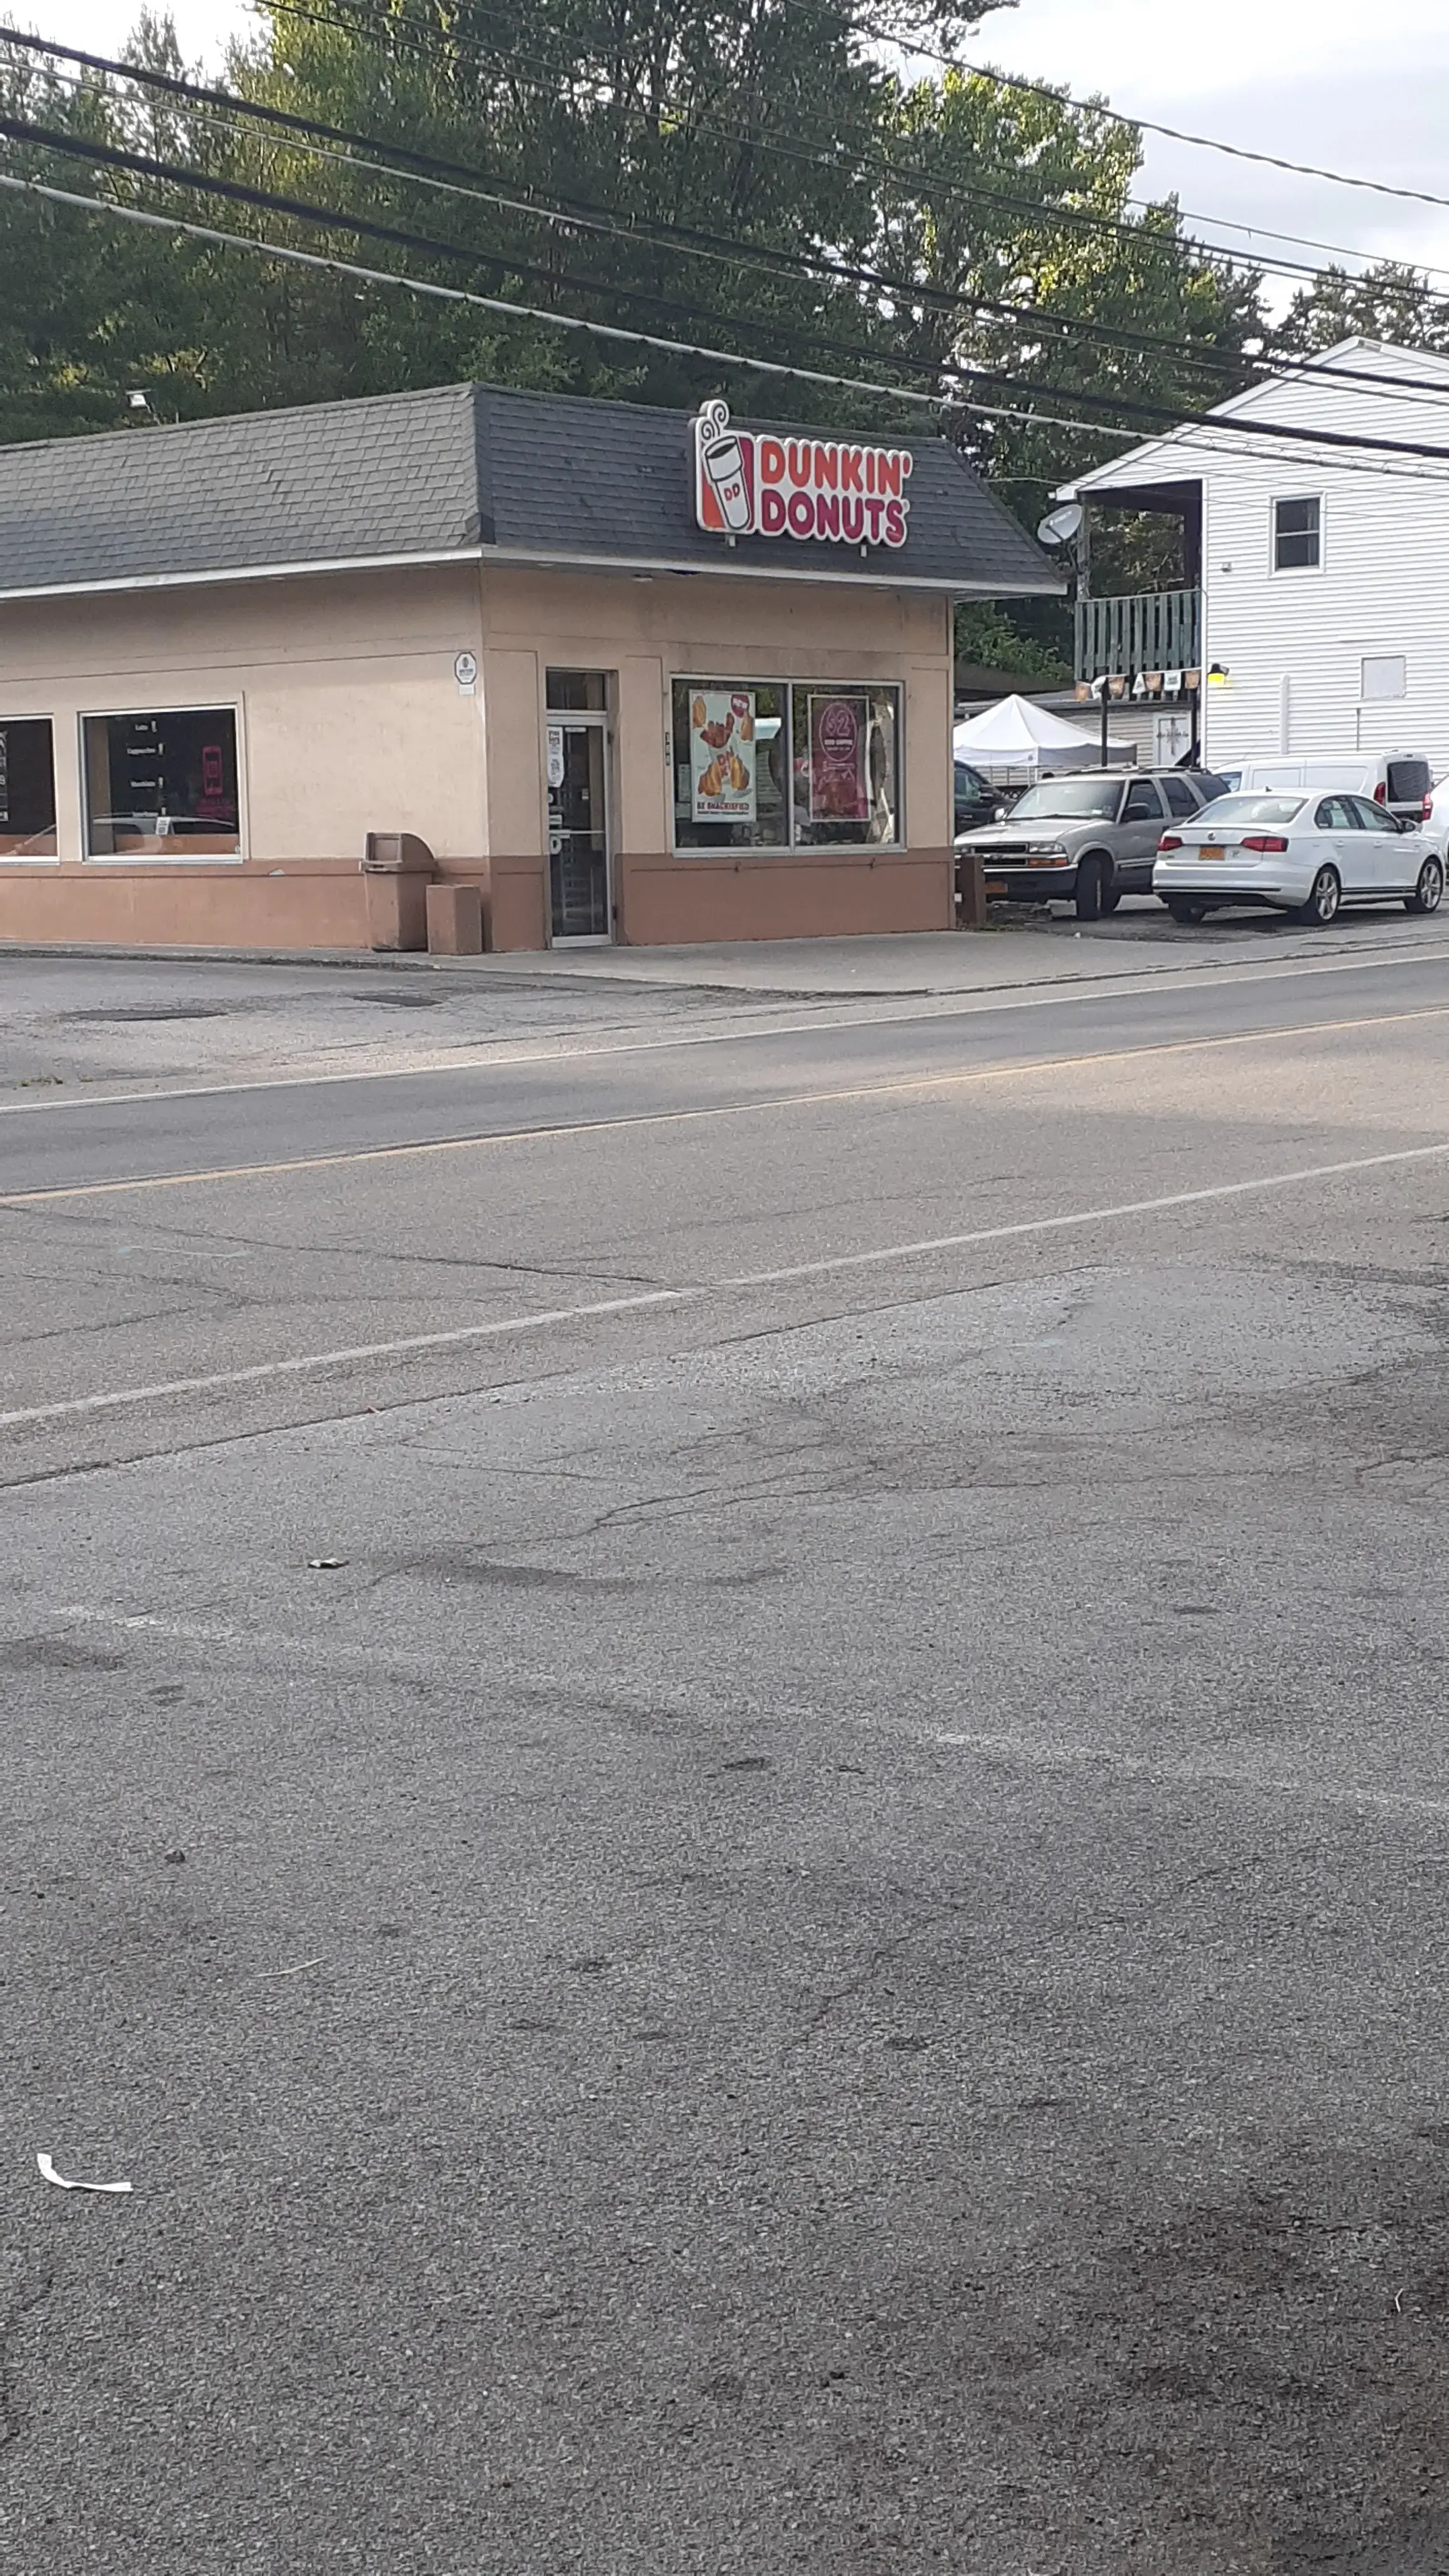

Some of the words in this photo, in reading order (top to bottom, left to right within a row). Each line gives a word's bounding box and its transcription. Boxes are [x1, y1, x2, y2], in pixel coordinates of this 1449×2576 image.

[724, 483, 740, 501] DD
[761, 440, 910, 497] DUNKIN'
[761, 489, 904, 544] DONUTS
